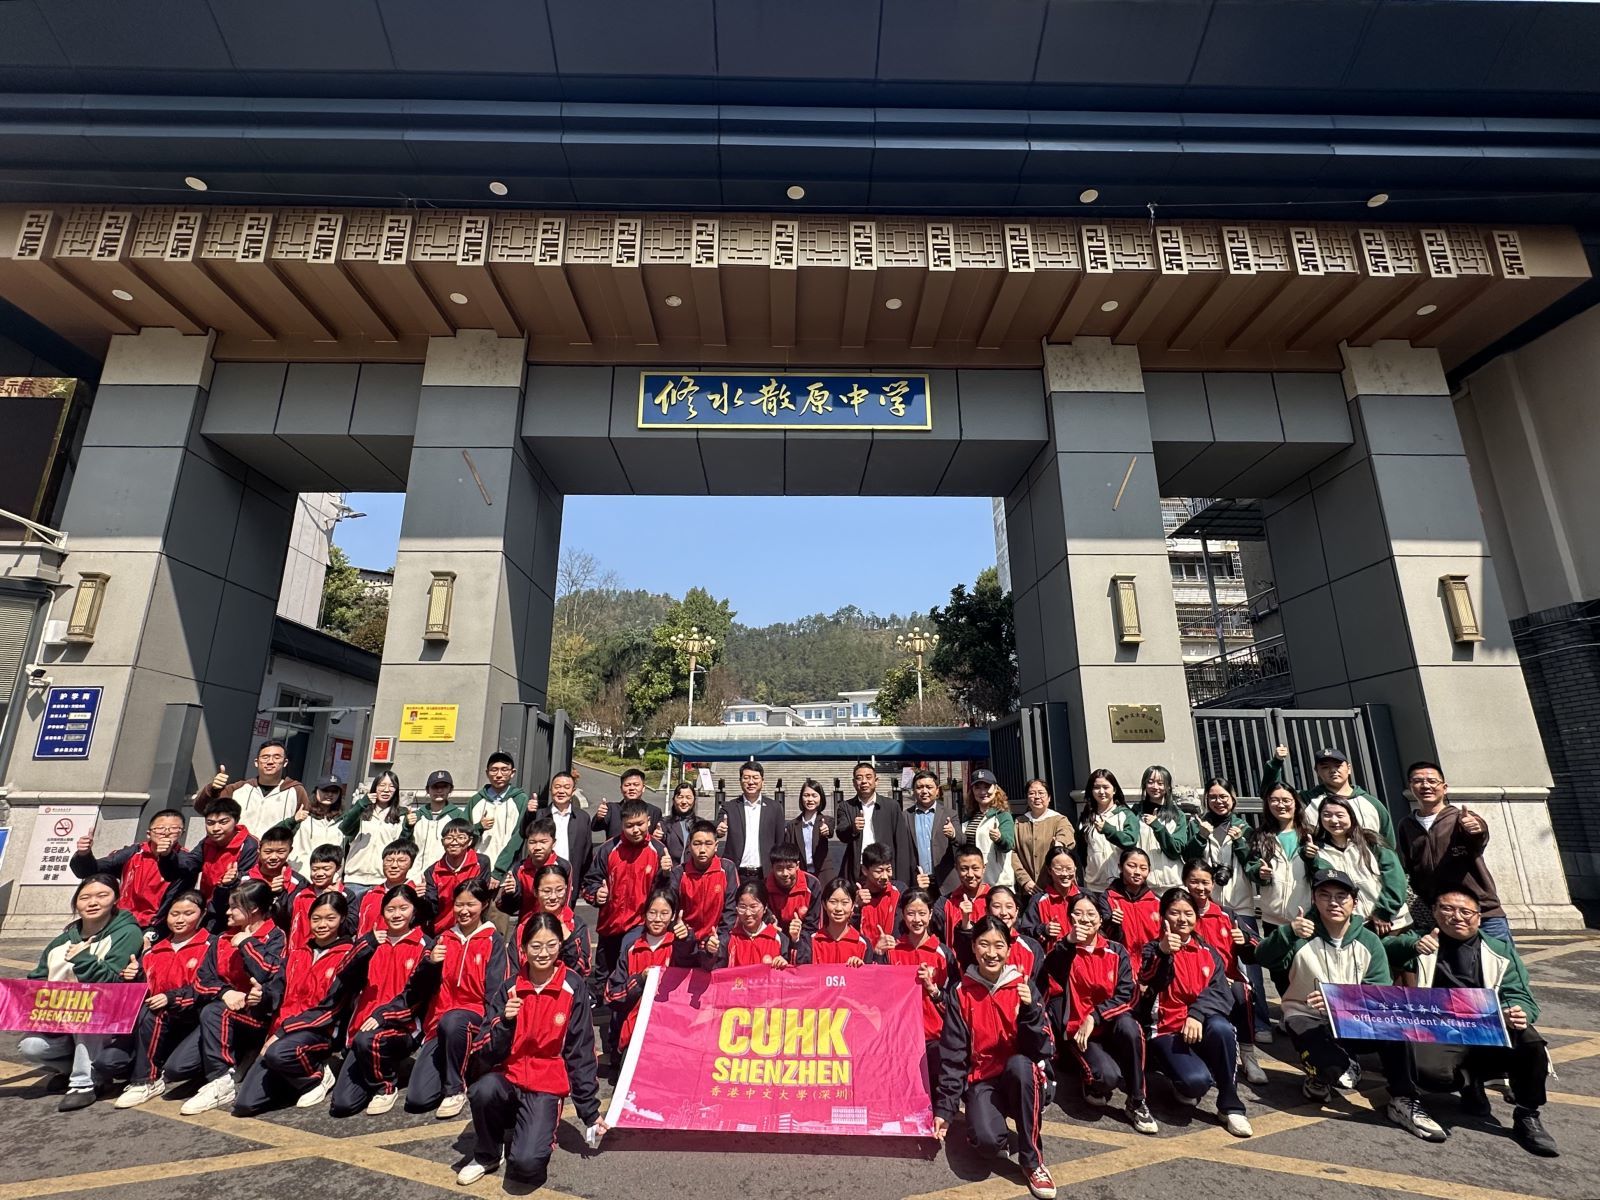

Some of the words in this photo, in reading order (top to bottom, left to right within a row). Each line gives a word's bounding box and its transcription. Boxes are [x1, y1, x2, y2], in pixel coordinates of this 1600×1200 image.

[655, 376, 909, 420] 修水散原中学
[41, 855, 70, 863] 无烟校园
[826, 975, 846, 987] OSA
[34, 988, 98, 1011] CUHK
[718, 1007, 851, 1058] CUHK
[1352, 1014, 1383, 1024] Office
[1384, 1015, 1394, 1025] of
[1396, 1015, 1438, 1027] Student
[1439, 1018, 1478, 1029] Affairs
[712, 1057, 851, 1086] SHENZHEN
